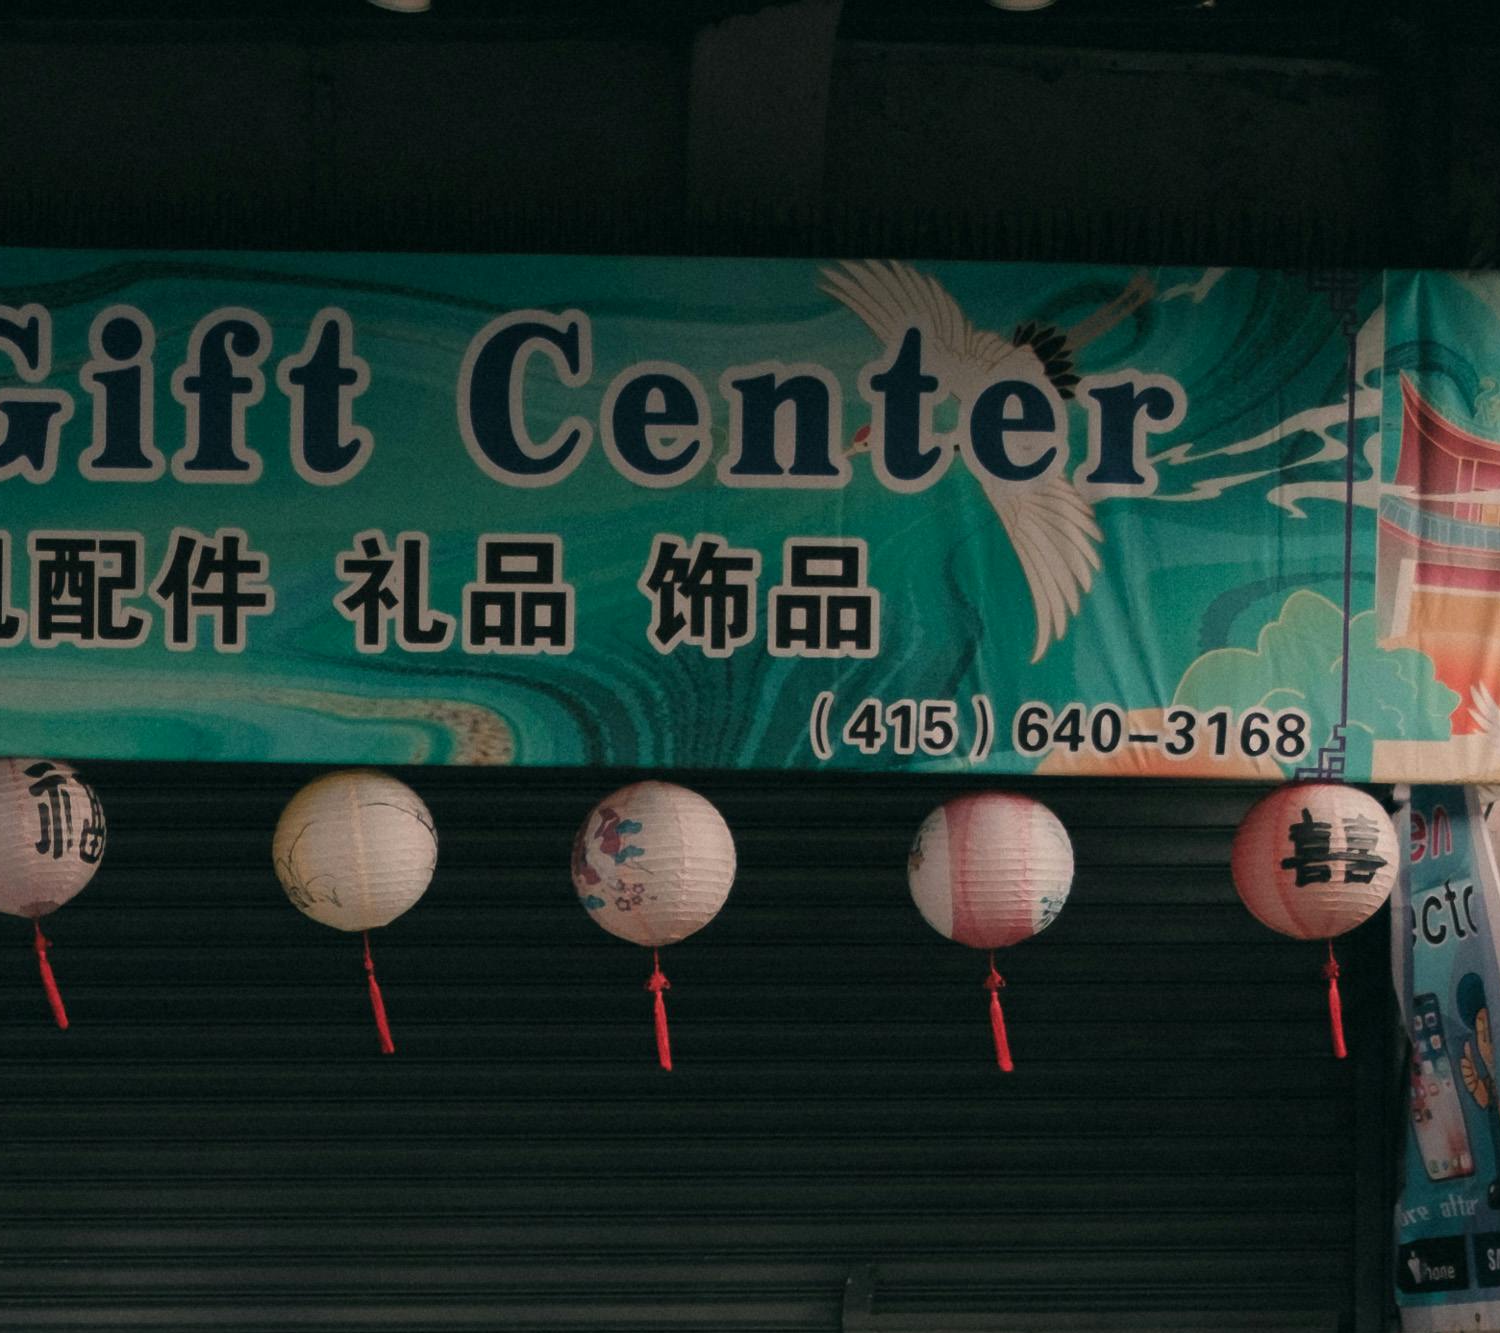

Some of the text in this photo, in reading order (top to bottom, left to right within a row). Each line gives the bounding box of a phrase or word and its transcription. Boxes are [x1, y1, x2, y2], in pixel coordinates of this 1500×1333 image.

[466, 315, 1178, 486] Center
[340, 536, 571, 649] 礼品
[645, 538, 877, 652] 饰品
[811, 696, 1307, 761] (415) 640-3168
